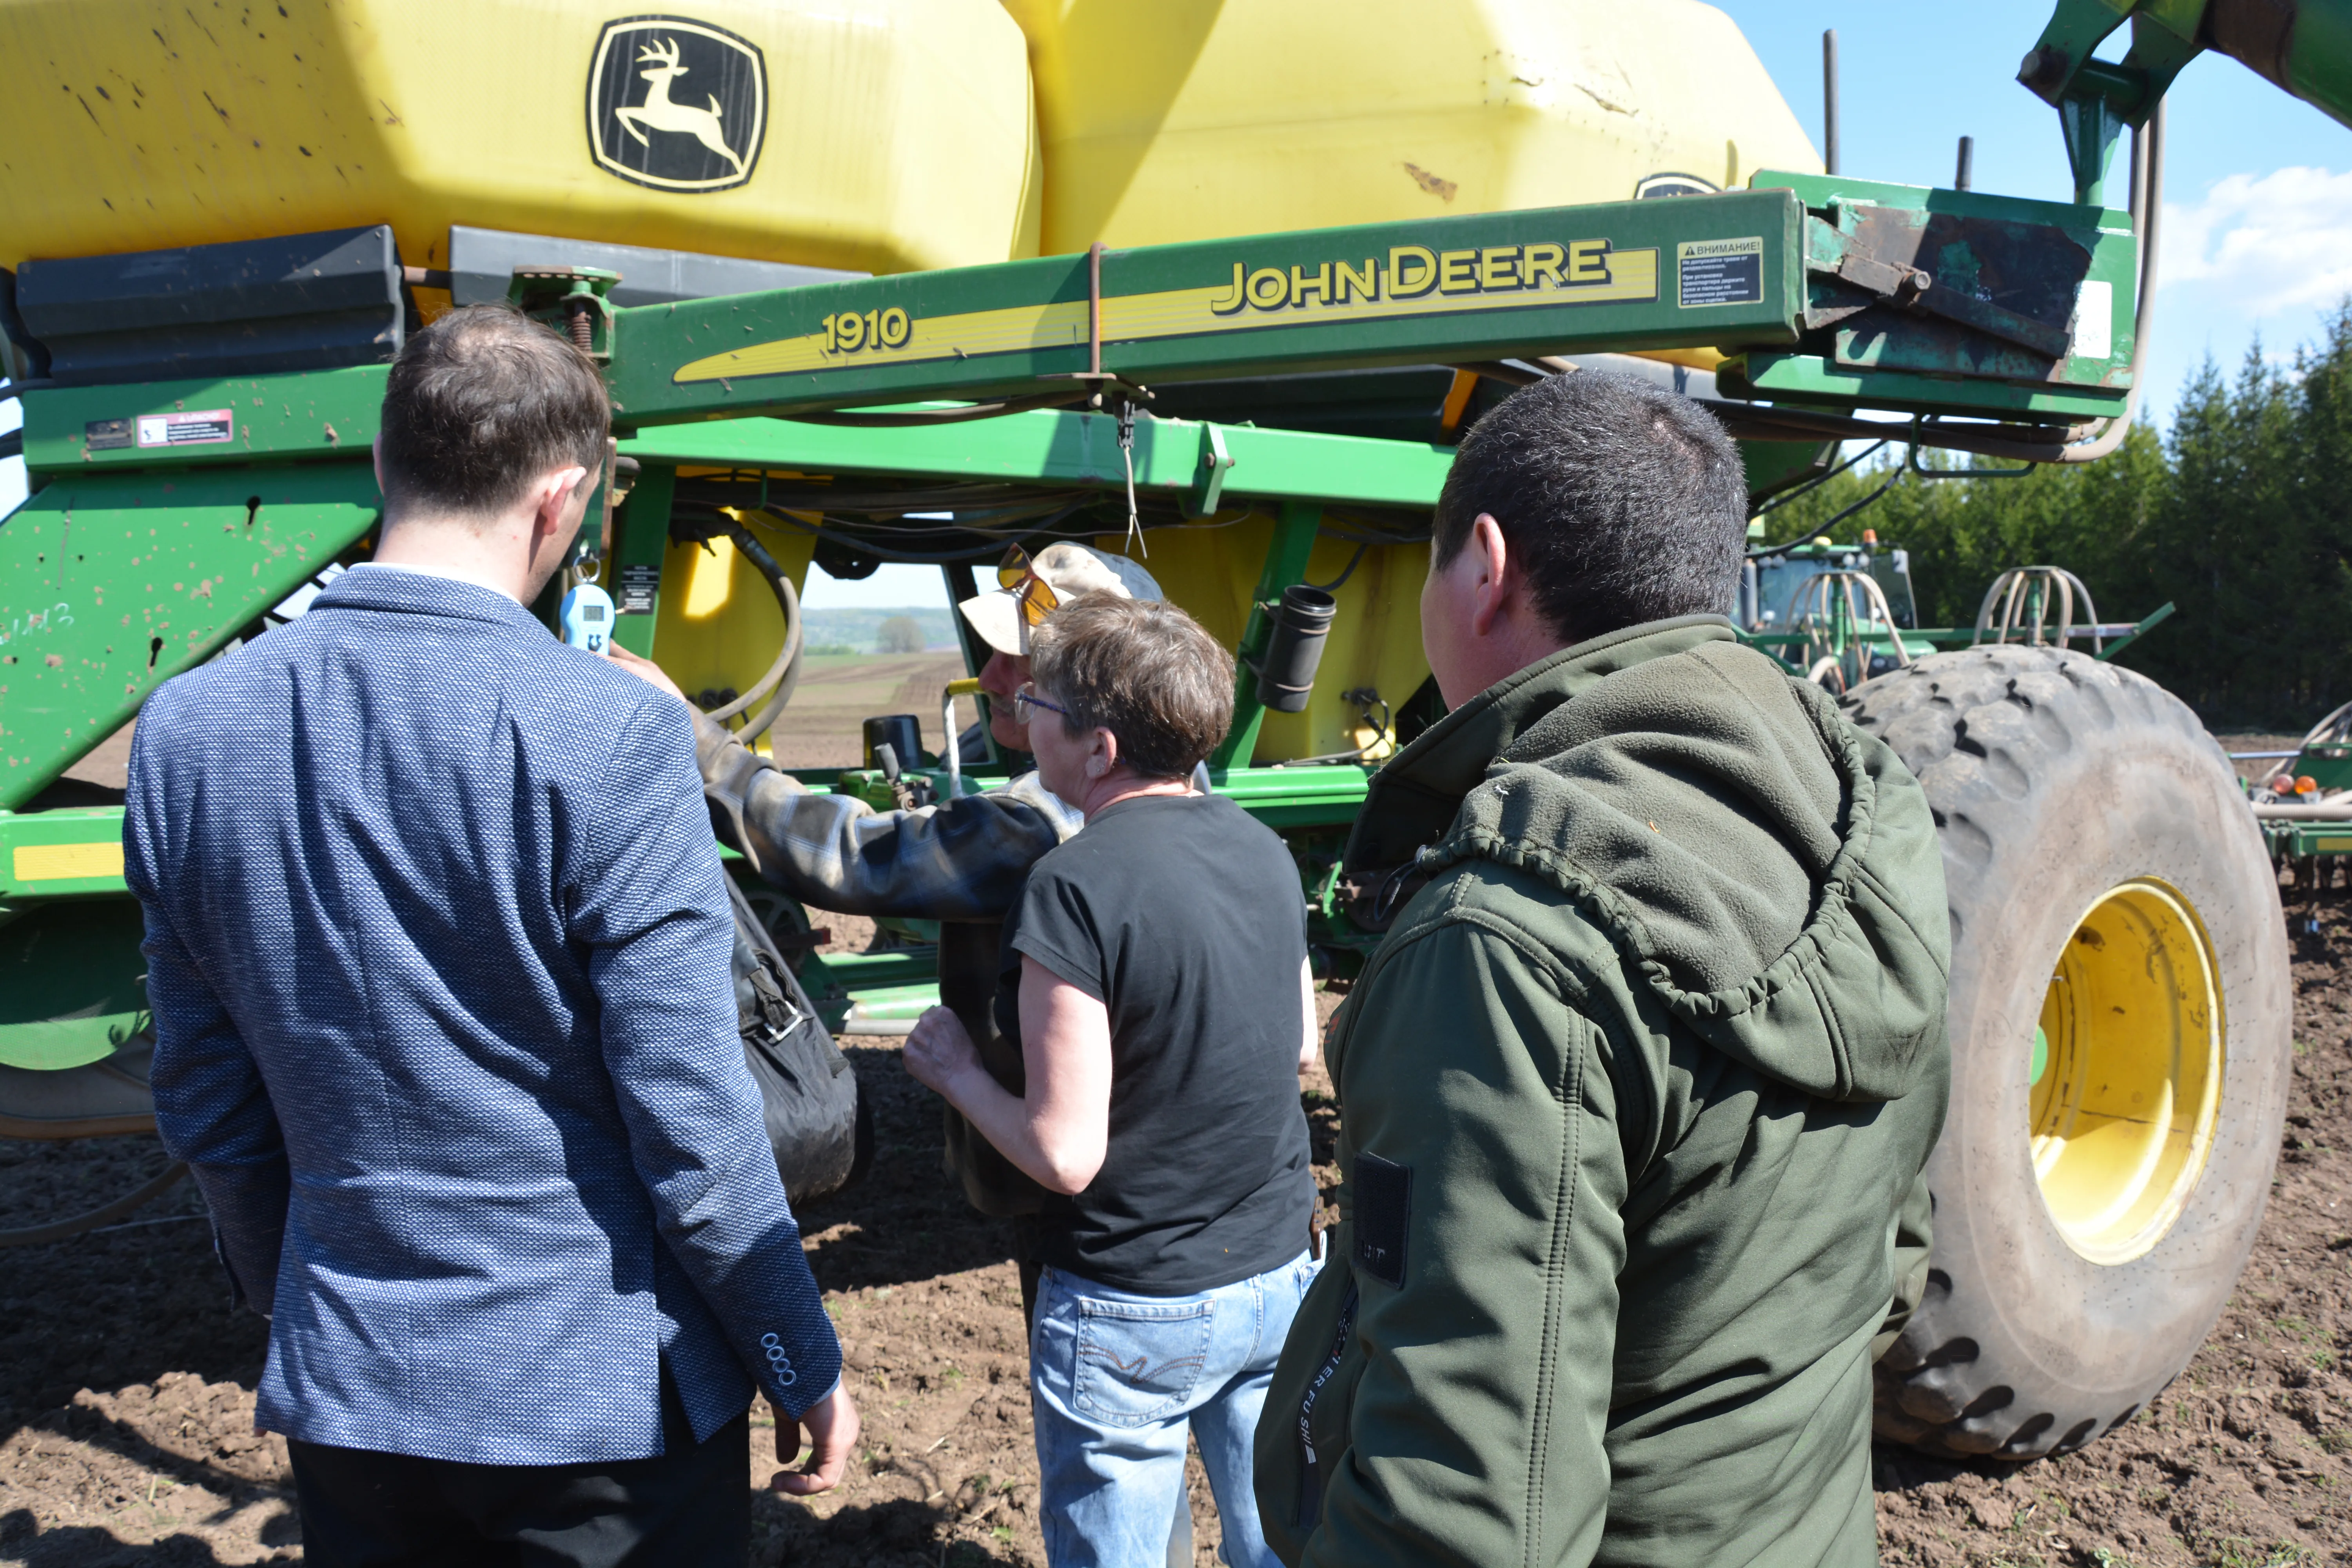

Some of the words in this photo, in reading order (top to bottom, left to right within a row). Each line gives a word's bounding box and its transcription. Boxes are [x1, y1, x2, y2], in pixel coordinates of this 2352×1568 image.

[1697, 241, 1760, 255] ВНИМАНИЕ!
[1212, 257, 1380, 316] JOHN
[1389, 238, 1612, 300] DEERE
[822, 307, 911, 354] 1910
[1314, 1365, 1333, 1387] ER
[1303, 1390, 1316, 1414] FU
[1301, 1417, 1312, 1445] SHI
